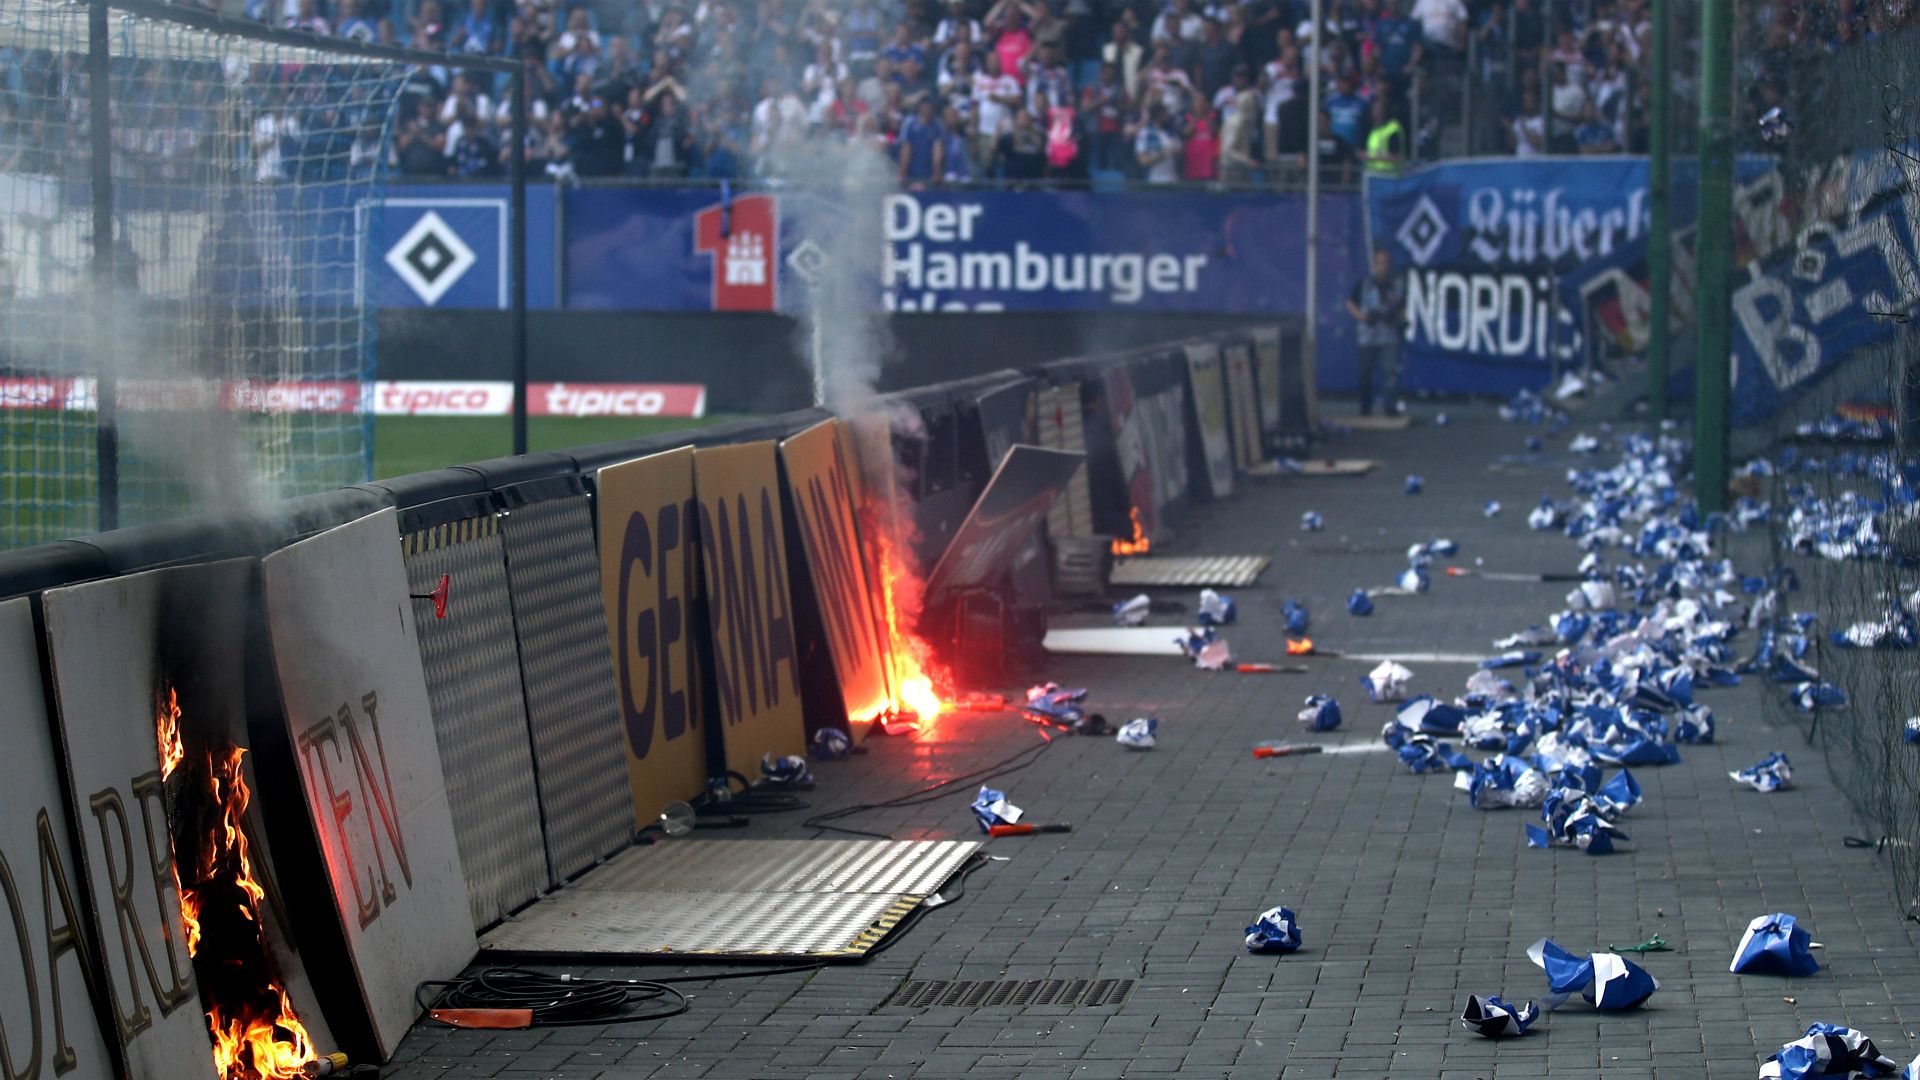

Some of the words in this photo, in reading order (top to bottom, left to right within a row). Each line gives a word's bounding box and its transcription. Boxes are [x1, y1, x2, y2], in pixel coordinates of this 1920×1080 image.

[882, 194, 983, 241] Der
[882, 243, 1206, 303] Hamburger
[383, 382, 489, 415] tipico
[547, 383, 666, 416] tipico
